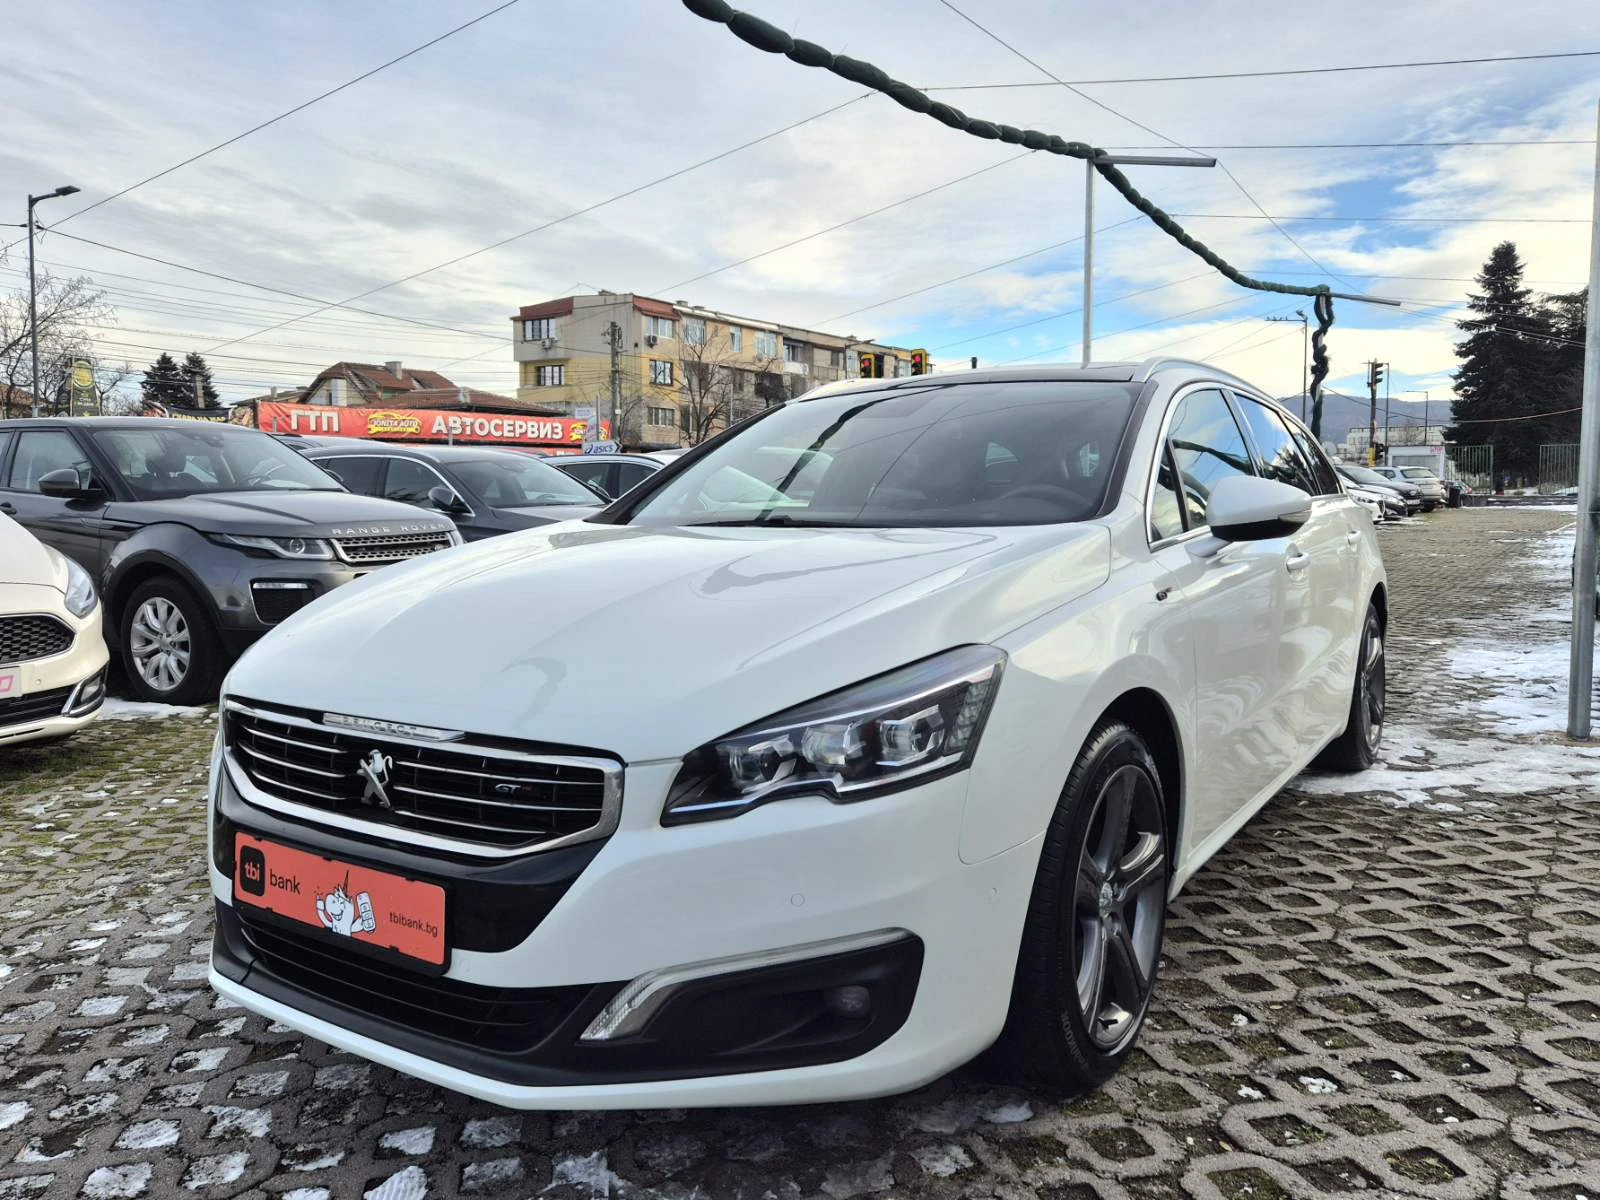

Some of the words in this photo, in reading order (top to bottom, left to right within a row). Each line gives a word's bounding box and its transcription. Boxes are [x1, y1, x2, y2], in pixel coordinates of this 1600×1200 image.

[291, 410, 340, 433] ГТП
[431, 415, 564, 439] АВТОСЕРВИЗ
[331, 527, 391, 535] RANGE
[400, 523, 446, 532] ROVER
[495, 784, 521, 793] GT
[244, 862, 260, 881] tbi
[269, 869, 301, 895] bank
[389, 912, 438, 938] tbibank.bg
